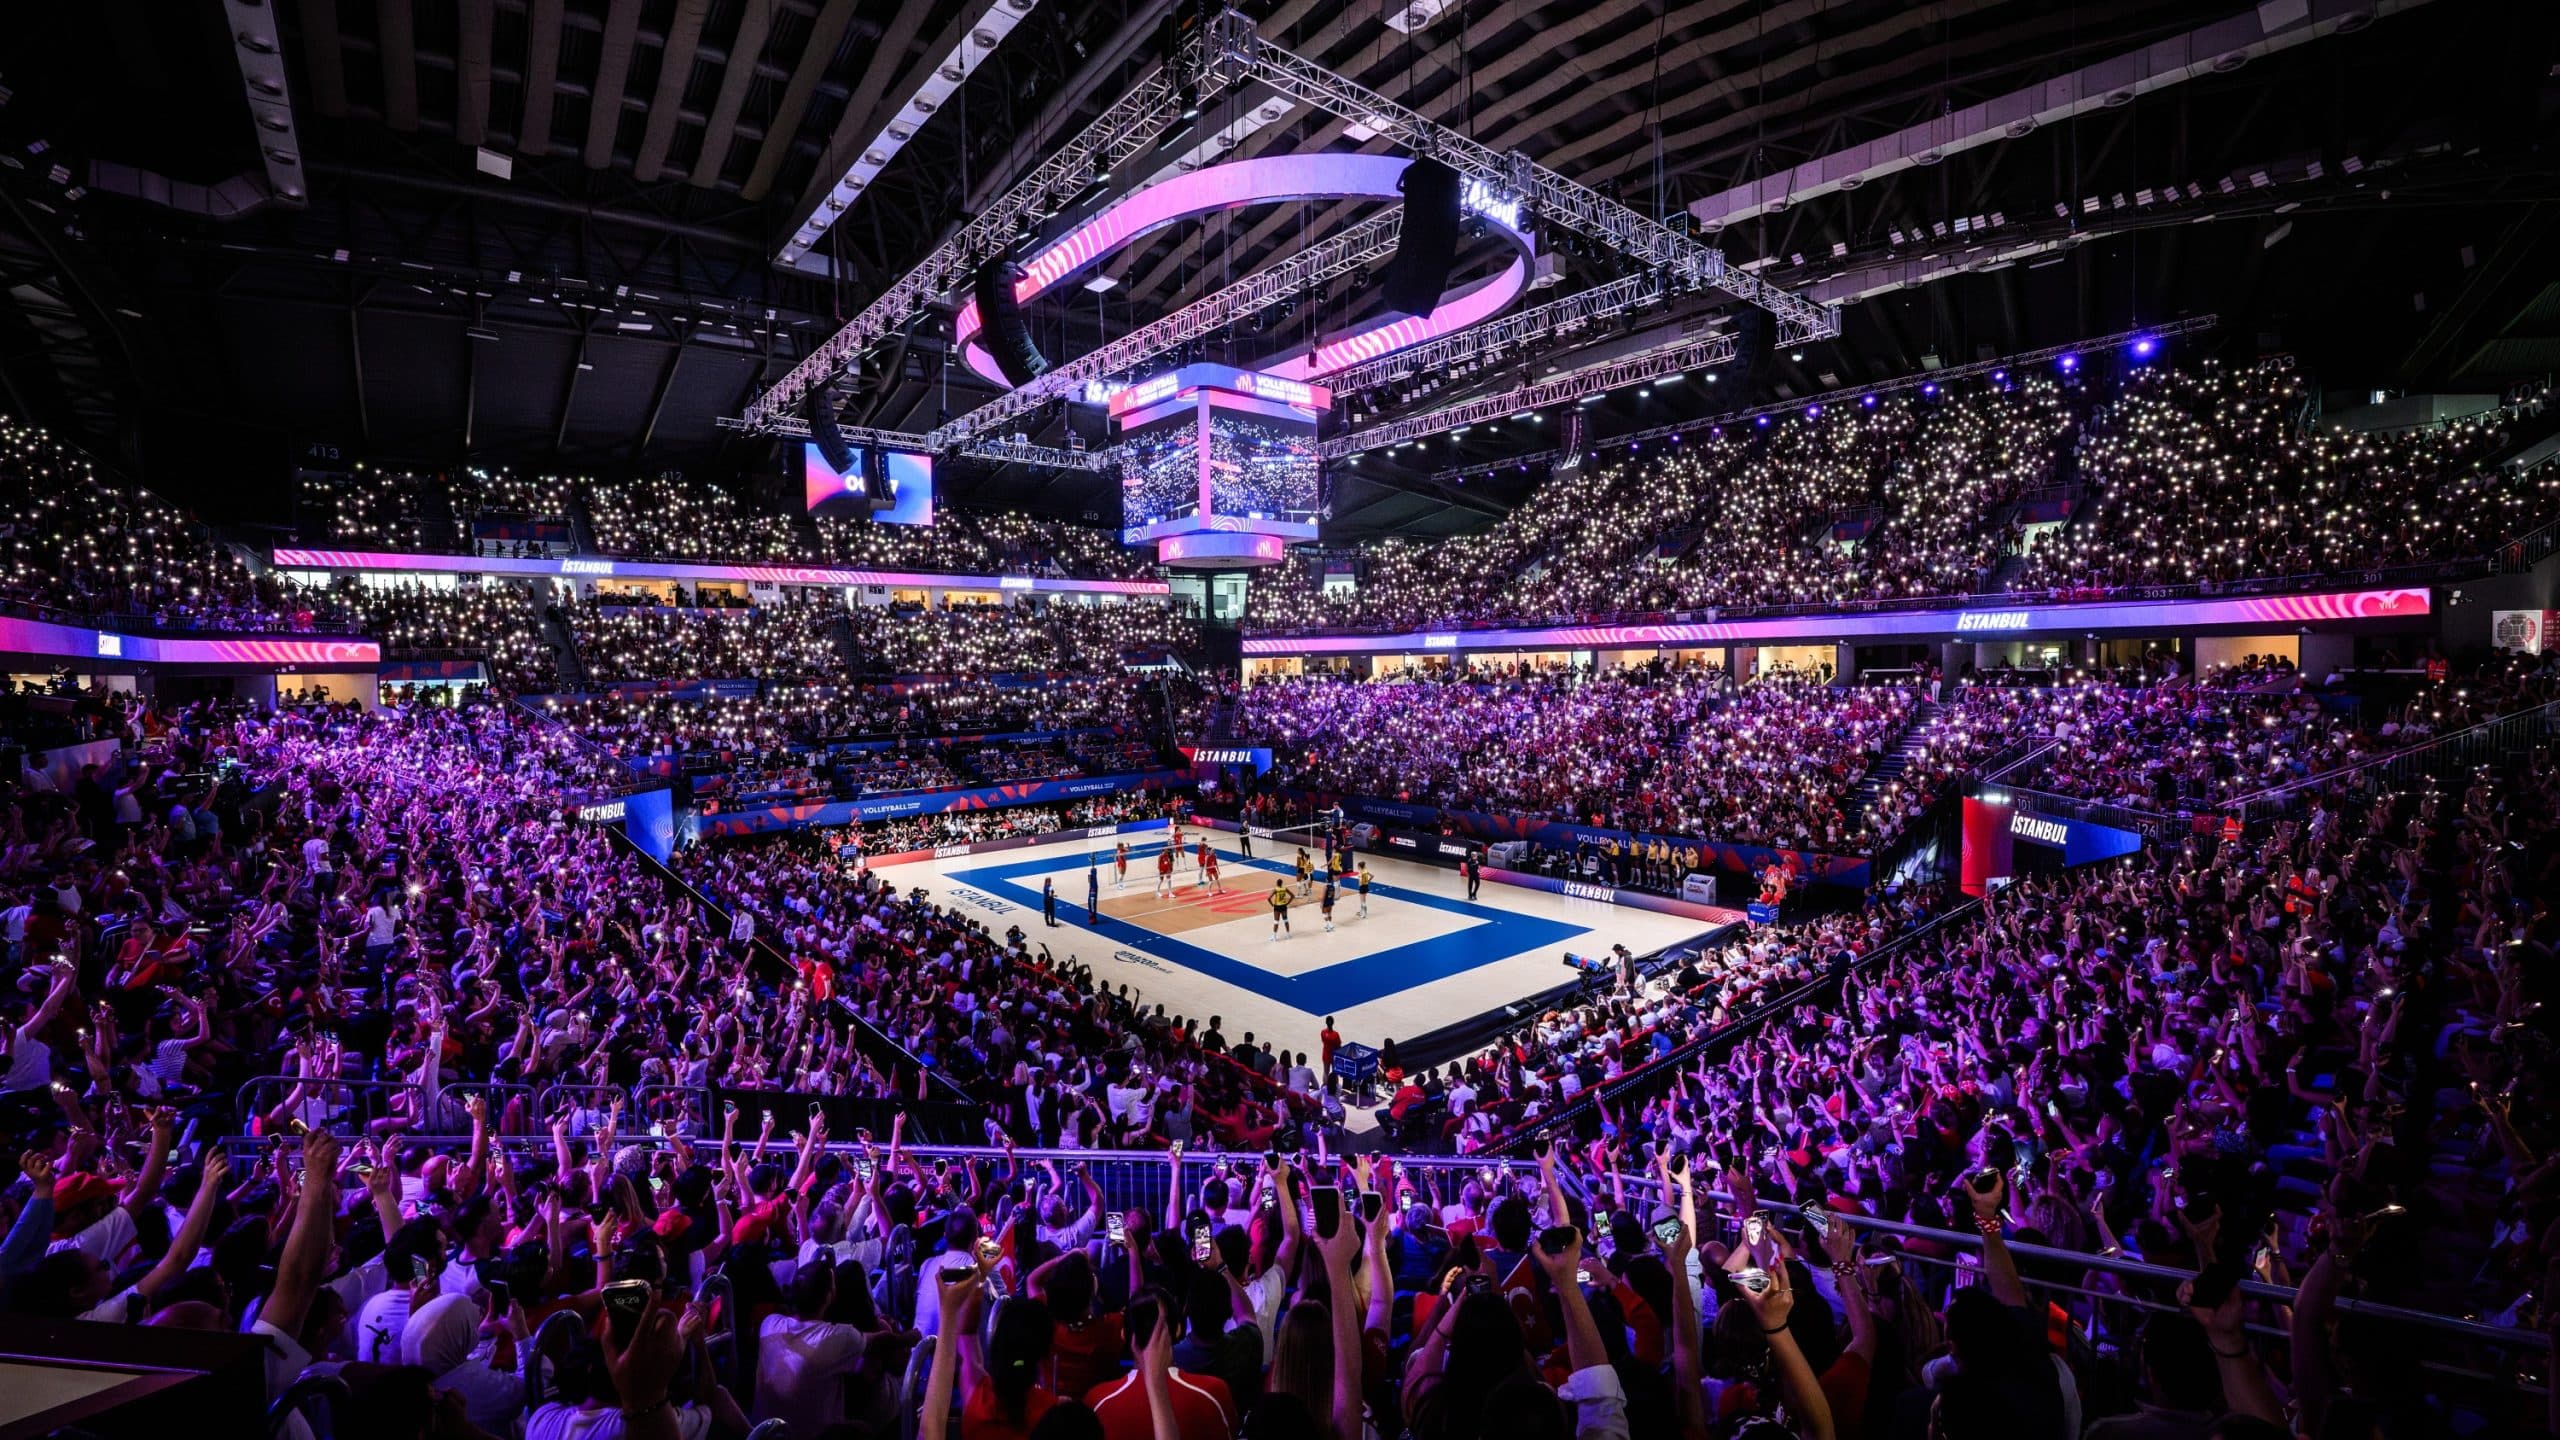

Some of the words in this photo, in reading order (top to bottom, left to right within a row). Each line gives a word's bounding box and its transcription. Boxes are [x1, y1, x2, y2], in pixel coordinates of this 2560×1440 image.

[1256, 375, 1310, 394] VOLLEYBALL
[307, 446, 341, 460] 413
[561, 559, 613, 574] İSTANBUL
[2362, 573, 2383, 584] 301
[2144, 588, 2167, 598] 303
[1956, 612, 2029, 630] İSTANBUL
[1193, 748, 1252, 762] İSTANBUL
[1069, 784, 1104, 793] VOLLEYBALL
[863, 804, 907, 814] VOLLEYBALL
[1362, 805, 1400, 817] VOLLEYBALL
[2017, 798, 2031, 811] 101
[1088, 826, 1117, 838] İSTANBUL
[1249, 826, 1273, 839] STANBUL
[2010, 811, 2068, 845] İSTANBUL
[2136, 822, 2156, 838] 126
[1576, 833, 1632, 849] VOLLEYALL
[934, 845, 971, 859] İSTANBUL
[1439, 842, 1467, 856] İSTANBUL
[1564, 881, 1616, 903] İSTANBUL
